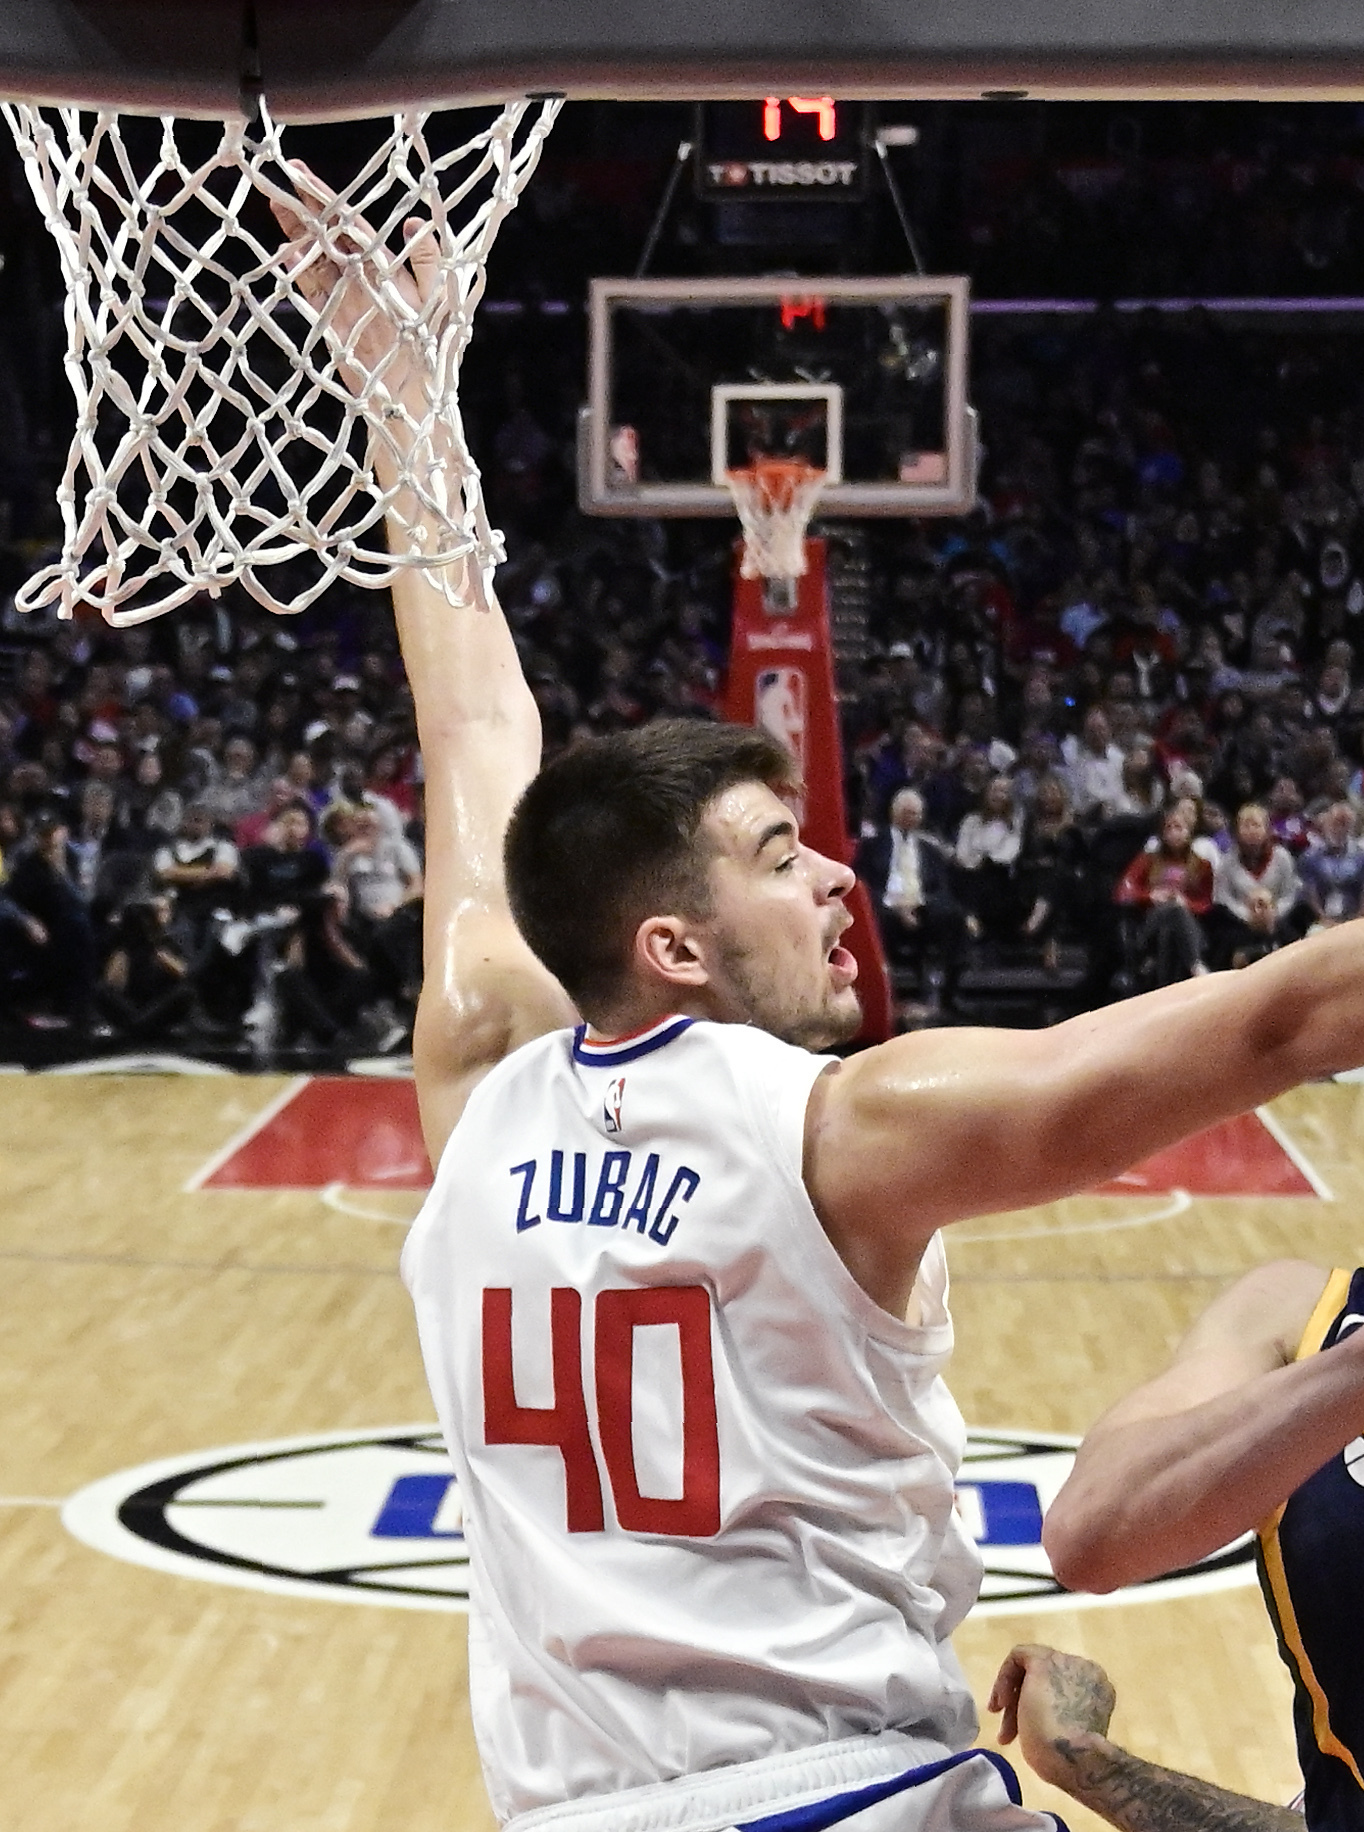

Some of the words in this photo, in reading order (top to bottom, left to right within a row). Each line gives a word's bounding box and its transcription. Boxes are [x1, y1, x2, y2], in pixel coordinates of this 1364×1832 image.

[748, 162, 858, 186] TISSOT
[508, 1149, 701, 1247] ZUBAC
[481, 1284, 722, 1537] 40
